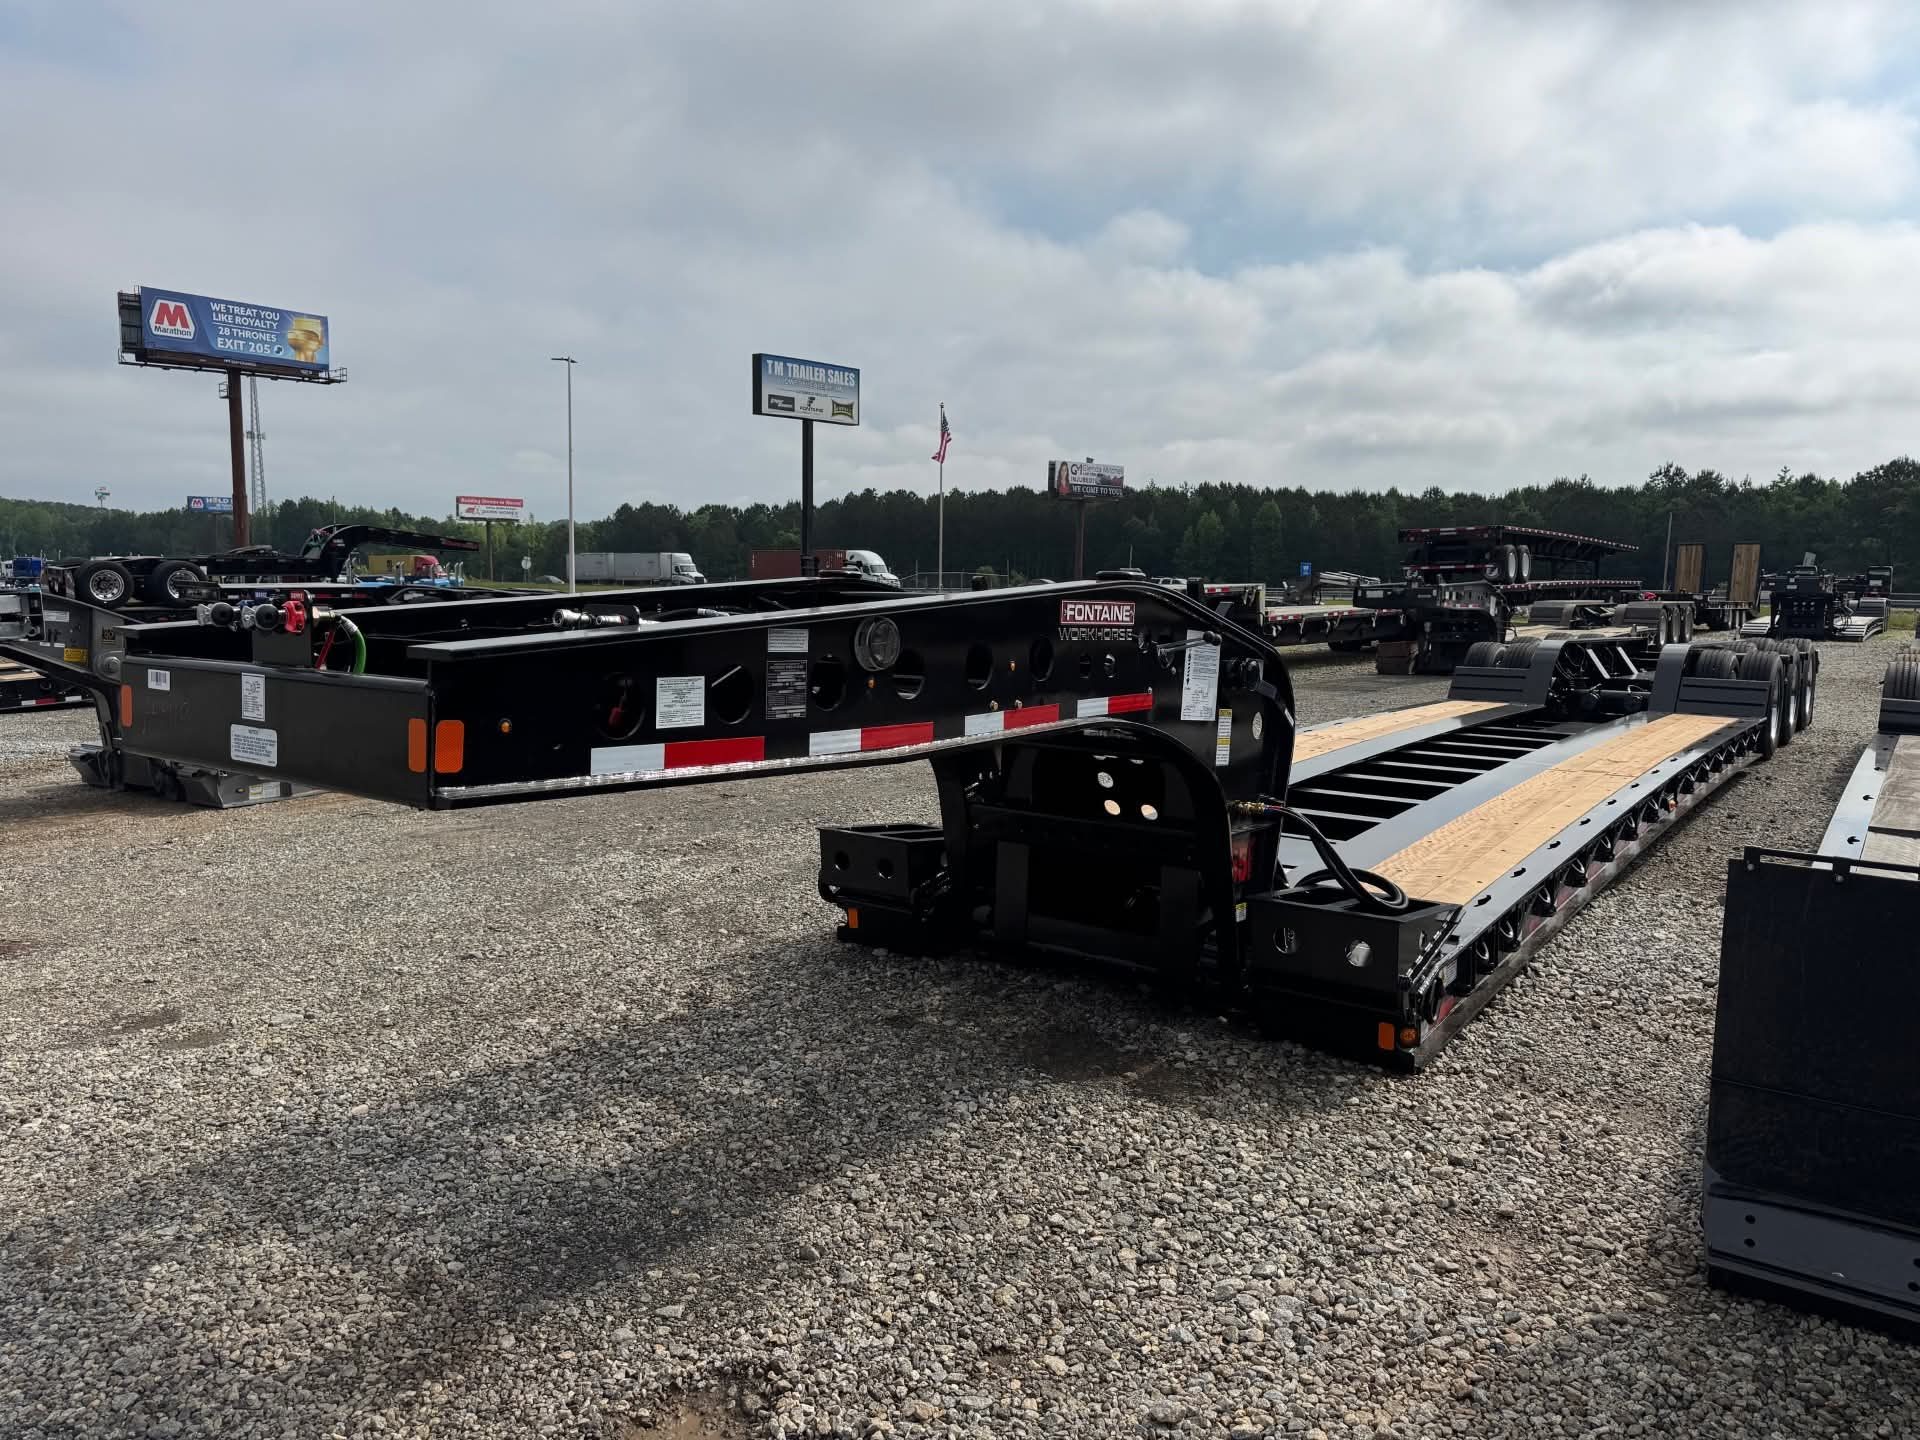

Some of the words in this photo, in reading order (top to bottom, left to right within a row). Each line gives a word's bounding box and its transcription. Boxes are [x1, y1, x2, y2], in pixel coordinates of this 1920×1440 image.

[210, 302, 226, 312] WE
[227, 304, 257, 317] TREAT
[258, 309, 280, 320] YOU
[212, 312, 234, 323] LIKE
[235, 316, 278, 329] ROYALTY
[154, 325, 192, 337] Marathon
[218, 326, 230, 336] 28
[232, 328, 277, 342] THRONES
[217, 337, 246, 351] EXIT
[248, 342, 271, 354] 205
[766, 360, 784, 376] TM
[786, 363, 826, 383] TRAILER
[827, 369, 855, 387] SALES
[1066, 604, 1131, 622] FONTAINE
[1058, 627, 1133, 641] WORKHORSE
